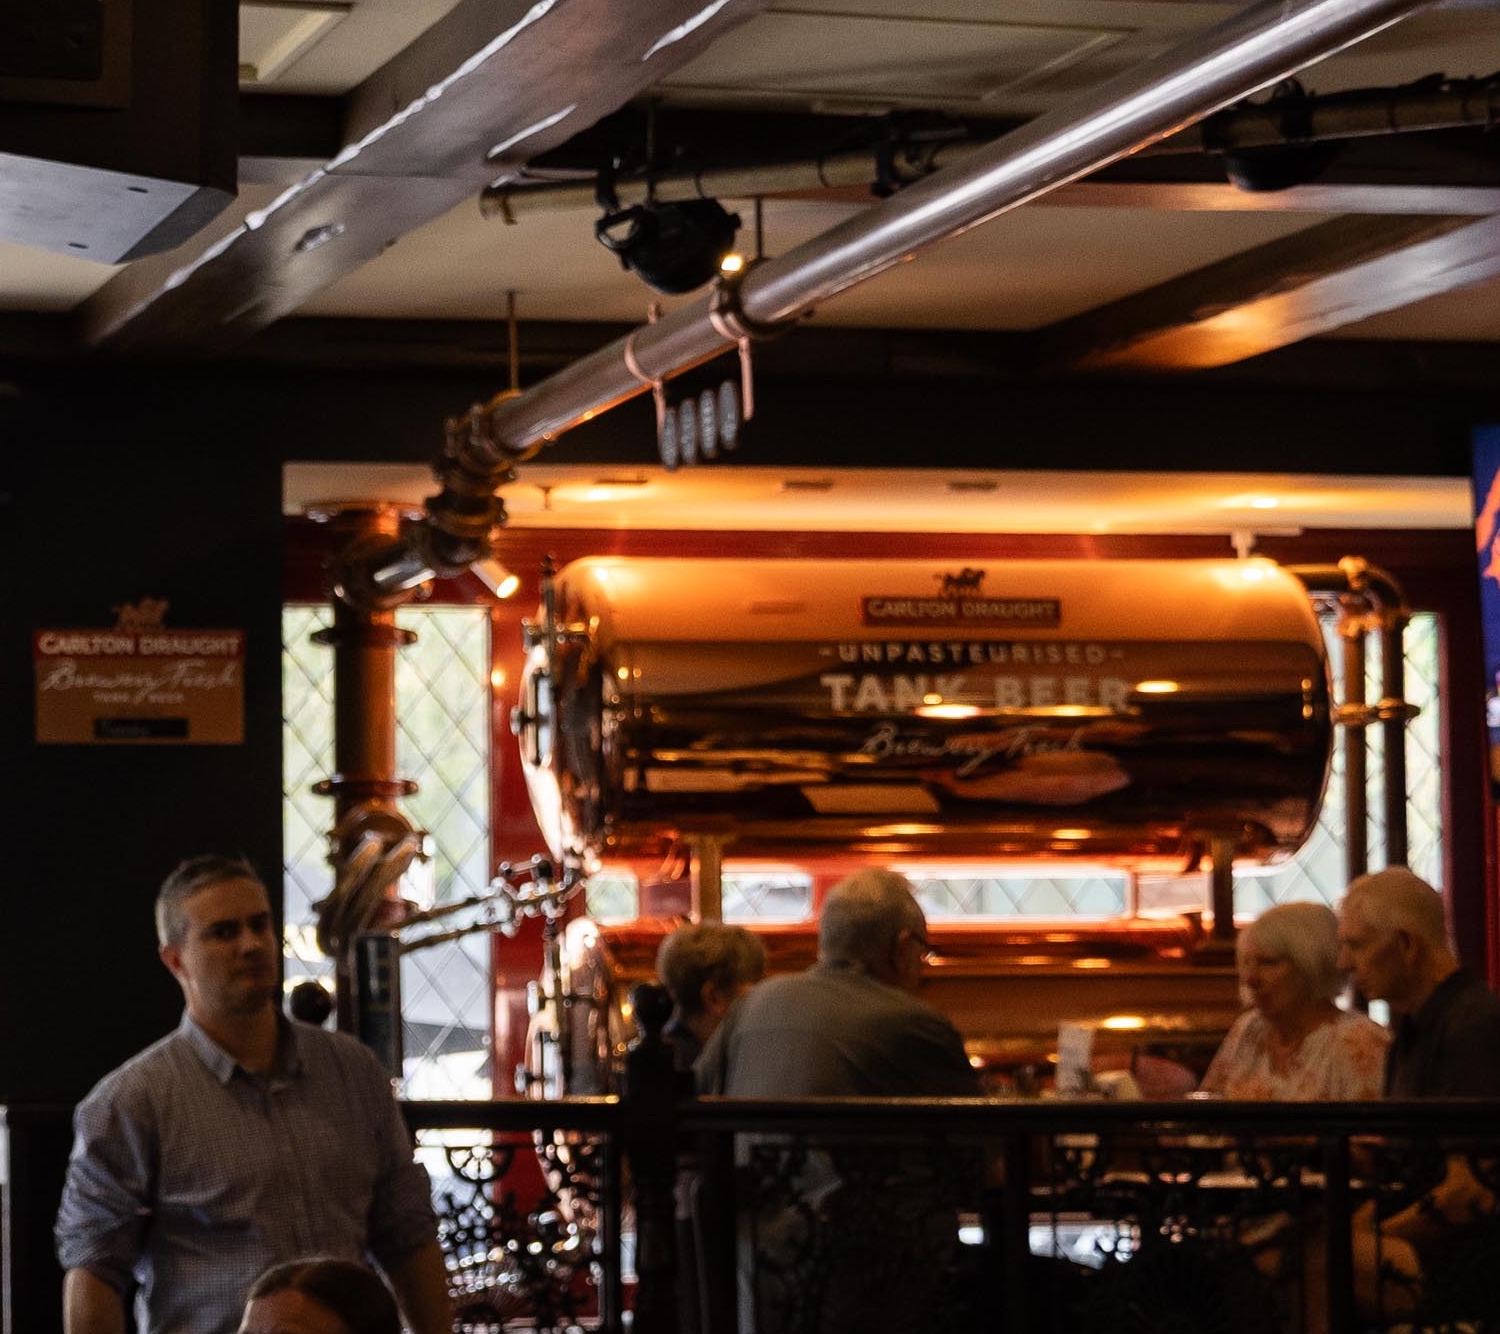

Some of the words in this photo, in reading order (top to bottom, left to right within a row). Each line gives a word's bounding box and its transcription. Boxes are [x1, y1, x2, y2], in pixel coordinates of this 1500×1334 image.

[866, 601, 956, 617] CARLTON
[961, 601, 1056, 617] DRAUGHT
[37, 632, 136, 656] CARLTON
[138, 633, 240, 656] DRAUGHT
[837, 642, 1105, 664] UNPASTEURISED
[819, 673, 969, 714] TANK
[994, 673, 1131, 714] BEER
[857, 723, 1006, 779] Brewery
